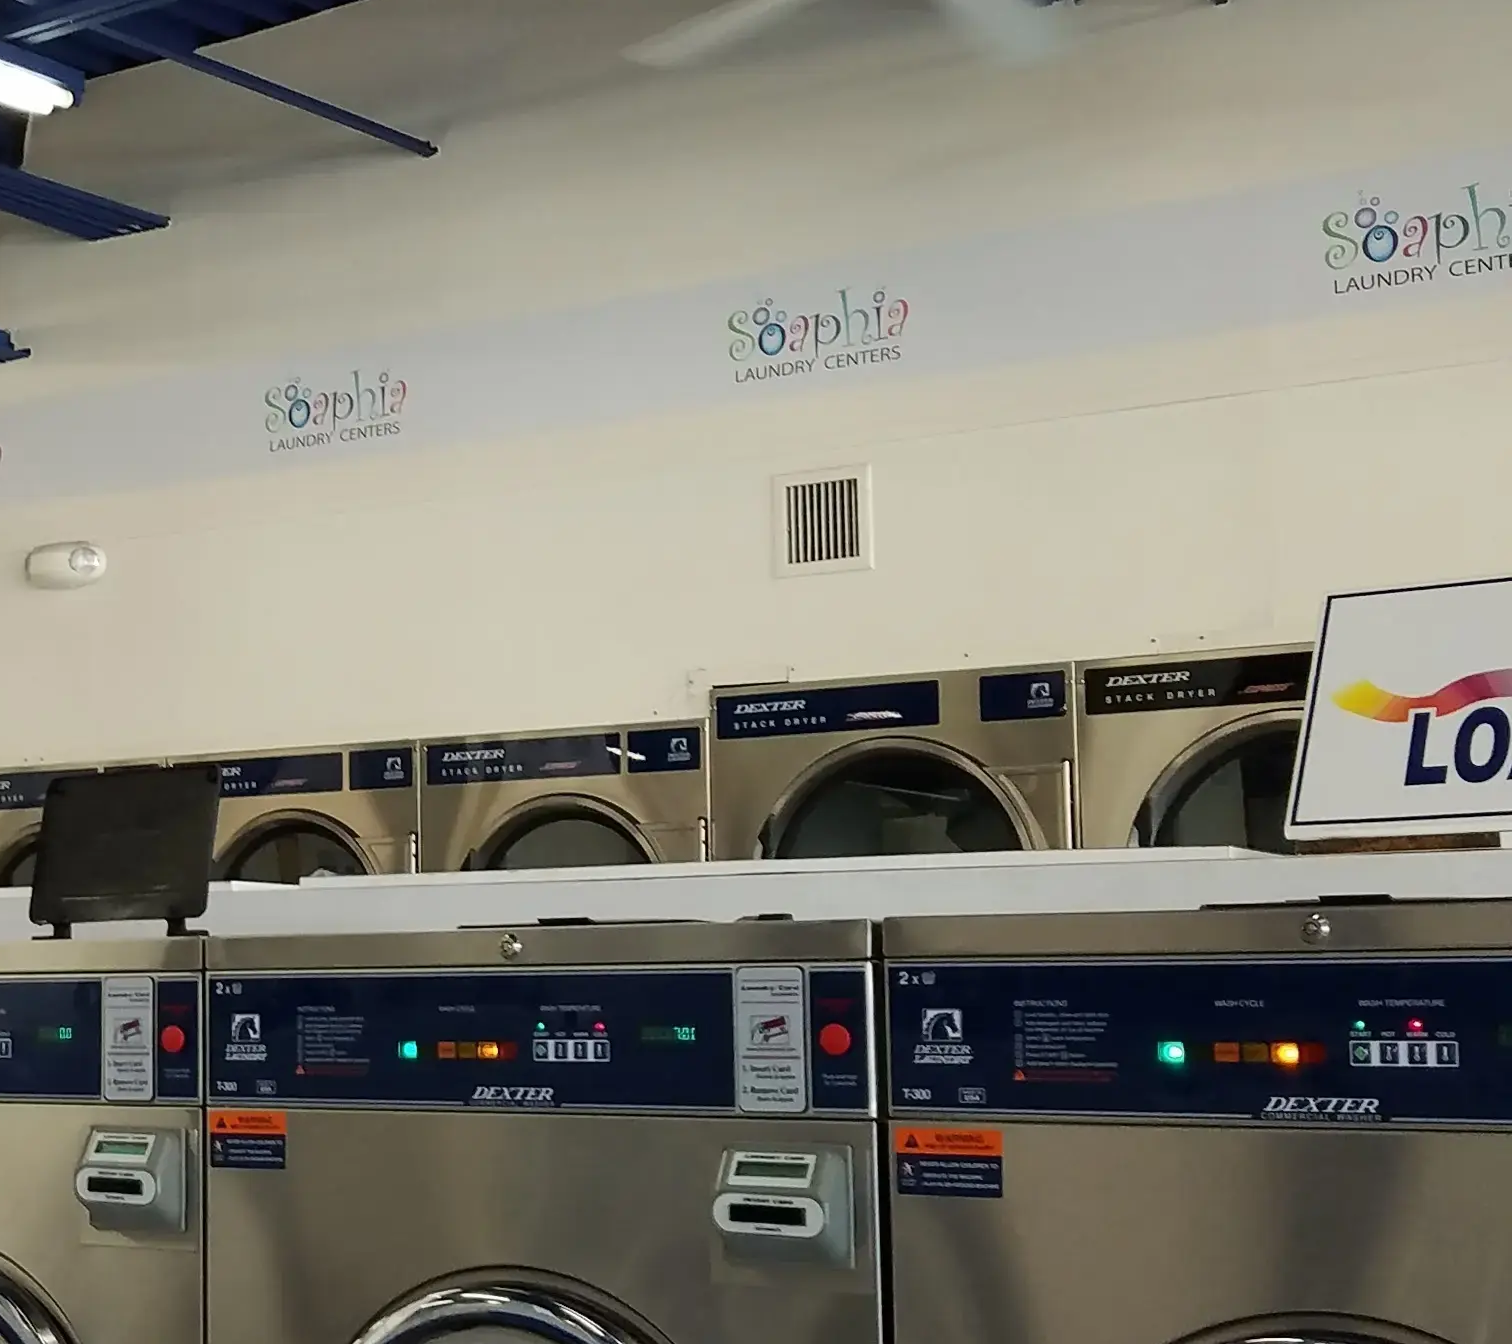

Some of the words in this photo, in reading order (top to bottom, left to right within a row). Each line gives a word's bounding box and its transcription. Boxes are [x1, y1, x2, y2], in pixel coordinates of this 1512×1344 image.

[1322, 182, 1512, 271] Soaph
[1334, 264, 1438, 295] LAUNDRY
[1449, 253, 1512, 278] CENT
[727, 286, 909, 362] Soaphia
[735, 358, 816, 384] LAUNDRY
[824, 345, 902, 370] CENTERS
[264, 369, 407, 433] Soaphia
[269, 431, 333, 453] LAUNDRY
[339, 421, 401, 442] CENTERS
[1105, 671, 1190, 688] DEXTER
[1105, 692, 1155, 705] STACK
[1166, 688, 1217, 700] DRYER
[734, 699, 807, 715] DEXTER
[734, 719, 777, 731] STACK
[784, 716, 828, 727] DRYER
[1404, 706, 1512, 786] LO
[442, 749, 506, 763] DEXTER
[899, 971, 910, 985] 2
[216, 982, 223, 995] 2
[1385, 999, 1446, 1007] TEMPERATURE
[225, 1043, 267, 1053] DEXTER
[914, 1044, 972, 1055] DEXTER
[472, 1086, 554, 1101] DEXTER
[902, 1088, 932, 1101] T-300
[1263, 1096, 1381, 1113] DEXTER
[1260, 1111, 1331, 1121] COMMERCIAL
[1337, 1113, 1383, 1122] WASHER
